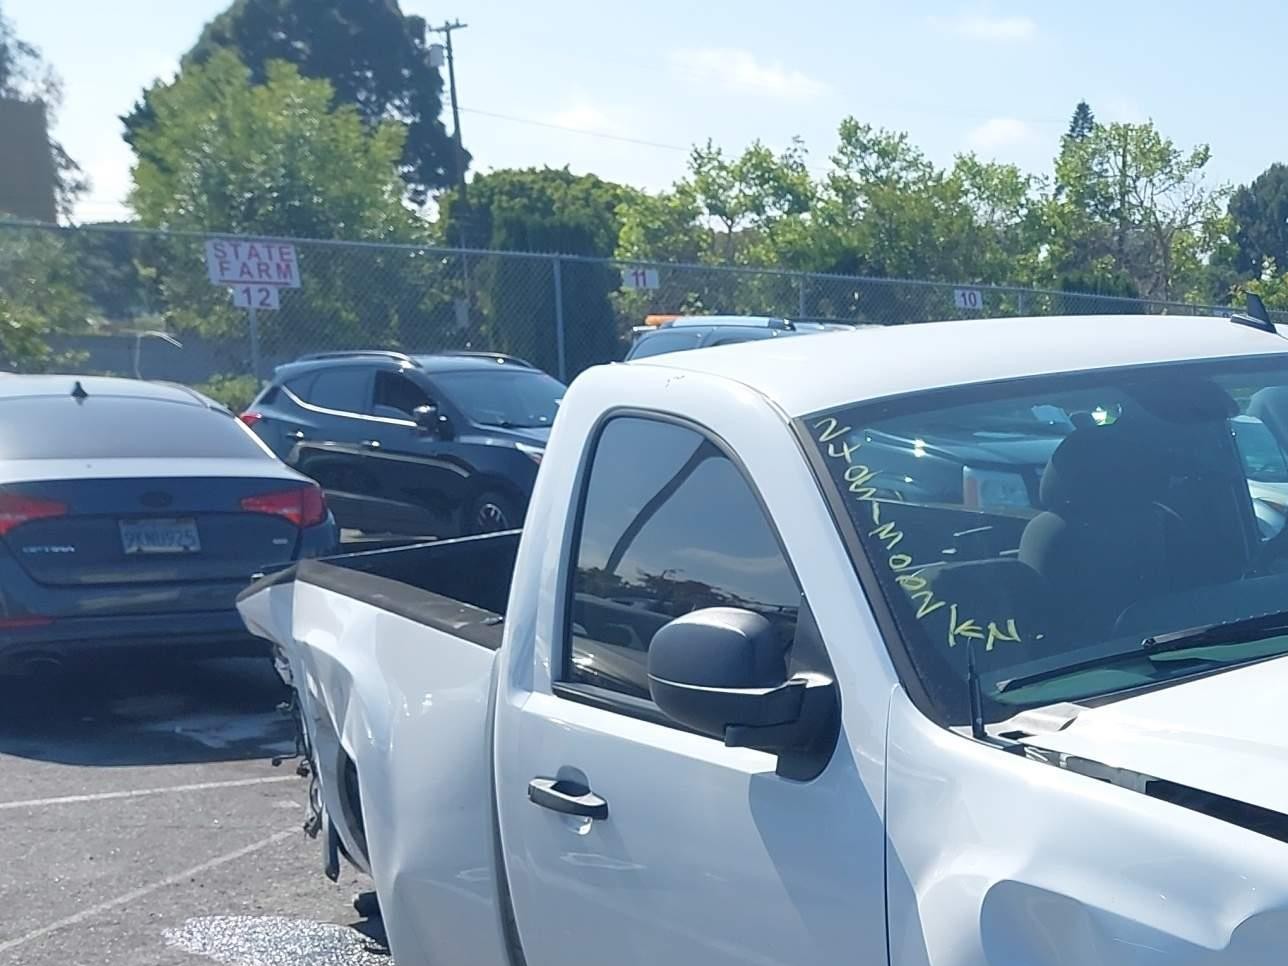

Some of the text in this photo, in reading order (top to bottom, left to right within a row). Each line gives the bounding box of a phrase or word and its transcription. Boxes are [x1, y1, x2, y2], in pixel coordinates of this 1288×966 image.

[213, 242, 292, 262] STATE
[219, 260, 292, 279] FARM
[632, 271, 647, 287] 11
[242, 286, 272, 307] 12
[961, 292, 977, 307] 10
